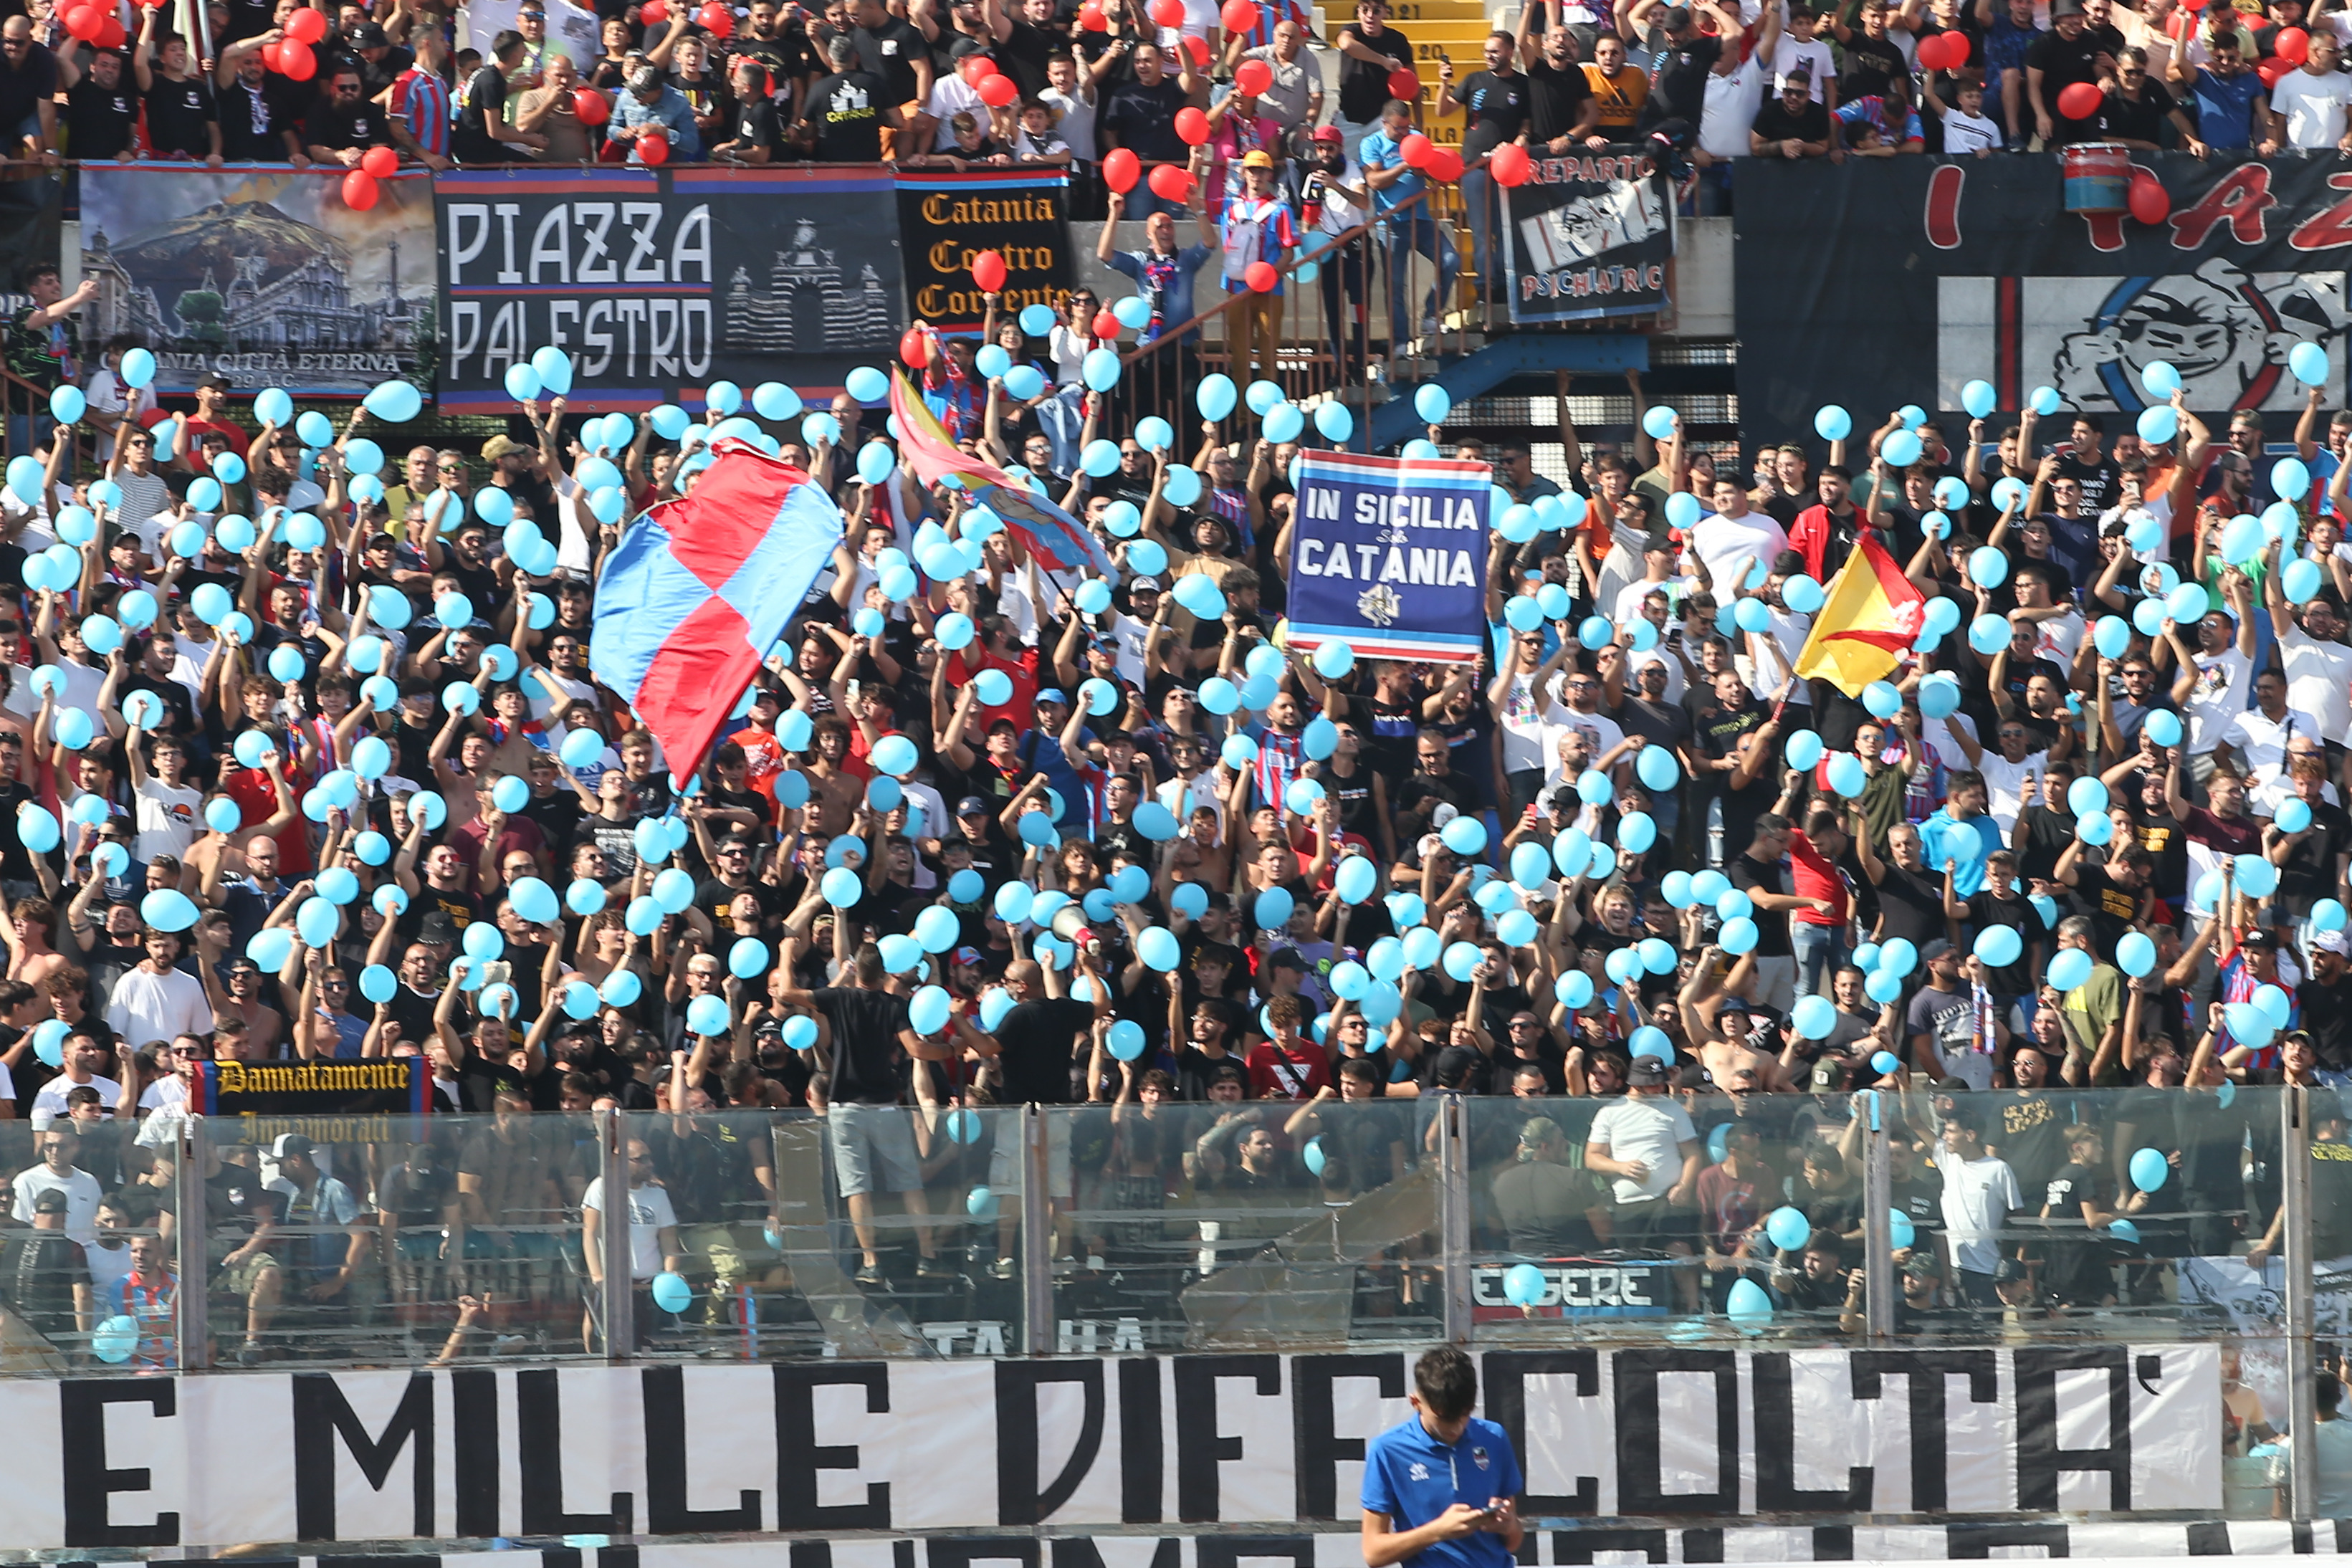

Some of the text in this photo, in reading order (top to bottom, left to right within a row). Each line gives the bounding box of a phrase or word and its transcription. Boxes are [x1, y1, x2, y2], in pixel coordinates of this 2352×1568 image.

[922, 193, 1056, 225] Catania
[448, 202, 712, 285] PIAZZA
[929, 239, 1053, 273] Cotro
[916, 284, 1073, 317] Corente
[296, 353, 401, 373] ETERNA
[1305, 487, 1480, 531] IN SICILIA
[1297, 538, 1477, 588] CATANIA
[214, 1060, 410, 1096] Dannatamente
[1471, 1268, 1652, 1306] ESERE
[60, 1344, 2161, 1548] E MILLE DIFFCOLTA'
